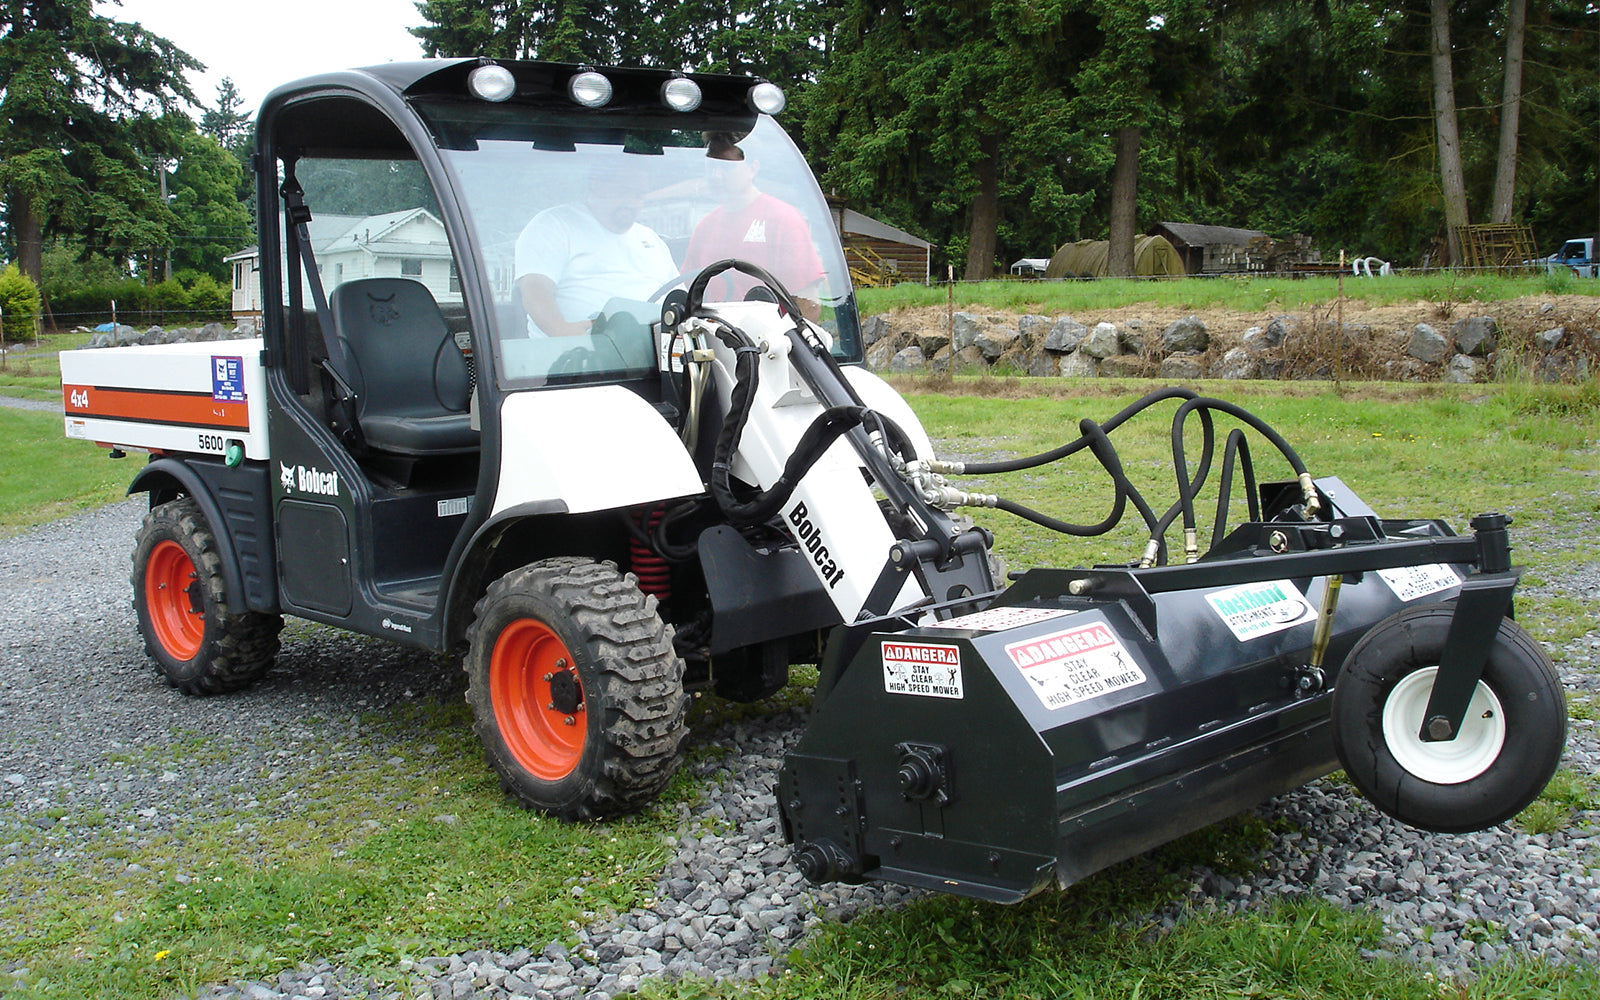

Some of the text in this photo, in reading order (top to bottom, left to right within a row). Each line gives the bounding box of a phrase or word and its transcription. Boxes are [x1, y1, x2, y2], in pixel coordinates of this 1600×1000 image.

[71, 389, 89, 408] 4x4
[198, 434, 224, 451] 5600
[297, 465, 339, 496] Bobcat
[788, 500, 845, 590] Bobcat
[1213, 583, 1288, 617] RockHound
[894, 646, 947, 663] DANGER
[1026, 631, 1100, 663] DANGER
[912, 665, 930, 674] STAY
[1063, 657, 1089, 673] STAY
[911, 674, 934, 684] CLEAR
[1069, 668, 1101, 685] CLEAR
[889, 682, 960, 696] HIGH SPEED MOWER
[1046, 670, 1141, 706] HIGH SPEED MOWER
